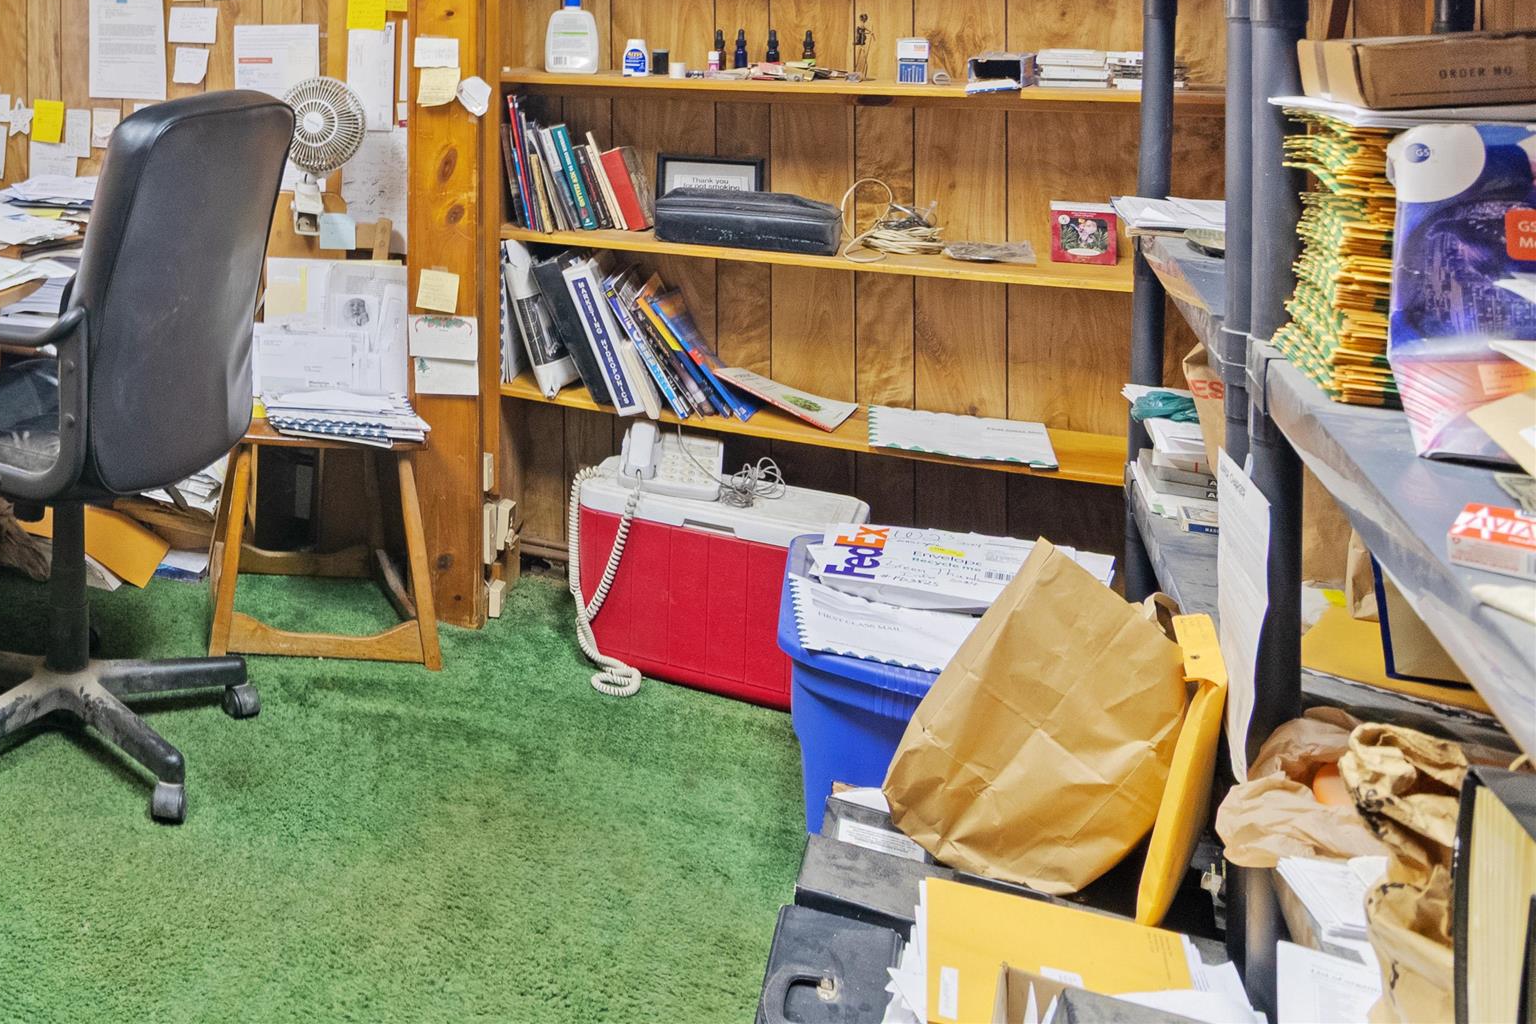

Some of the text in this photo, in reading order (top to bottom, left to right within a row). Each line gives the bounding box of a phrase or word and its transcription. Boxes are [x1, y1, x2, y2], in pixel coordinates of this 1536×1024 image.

[1439, 67, 1487, 80] ORDER
[577, 281, 630, 406] MARKETING HYDROPONICS
[824, 524, 890, 579] FedEx
[912, 550, 982, 567] Envelope
[912, 556, 960, 568] Recycle
